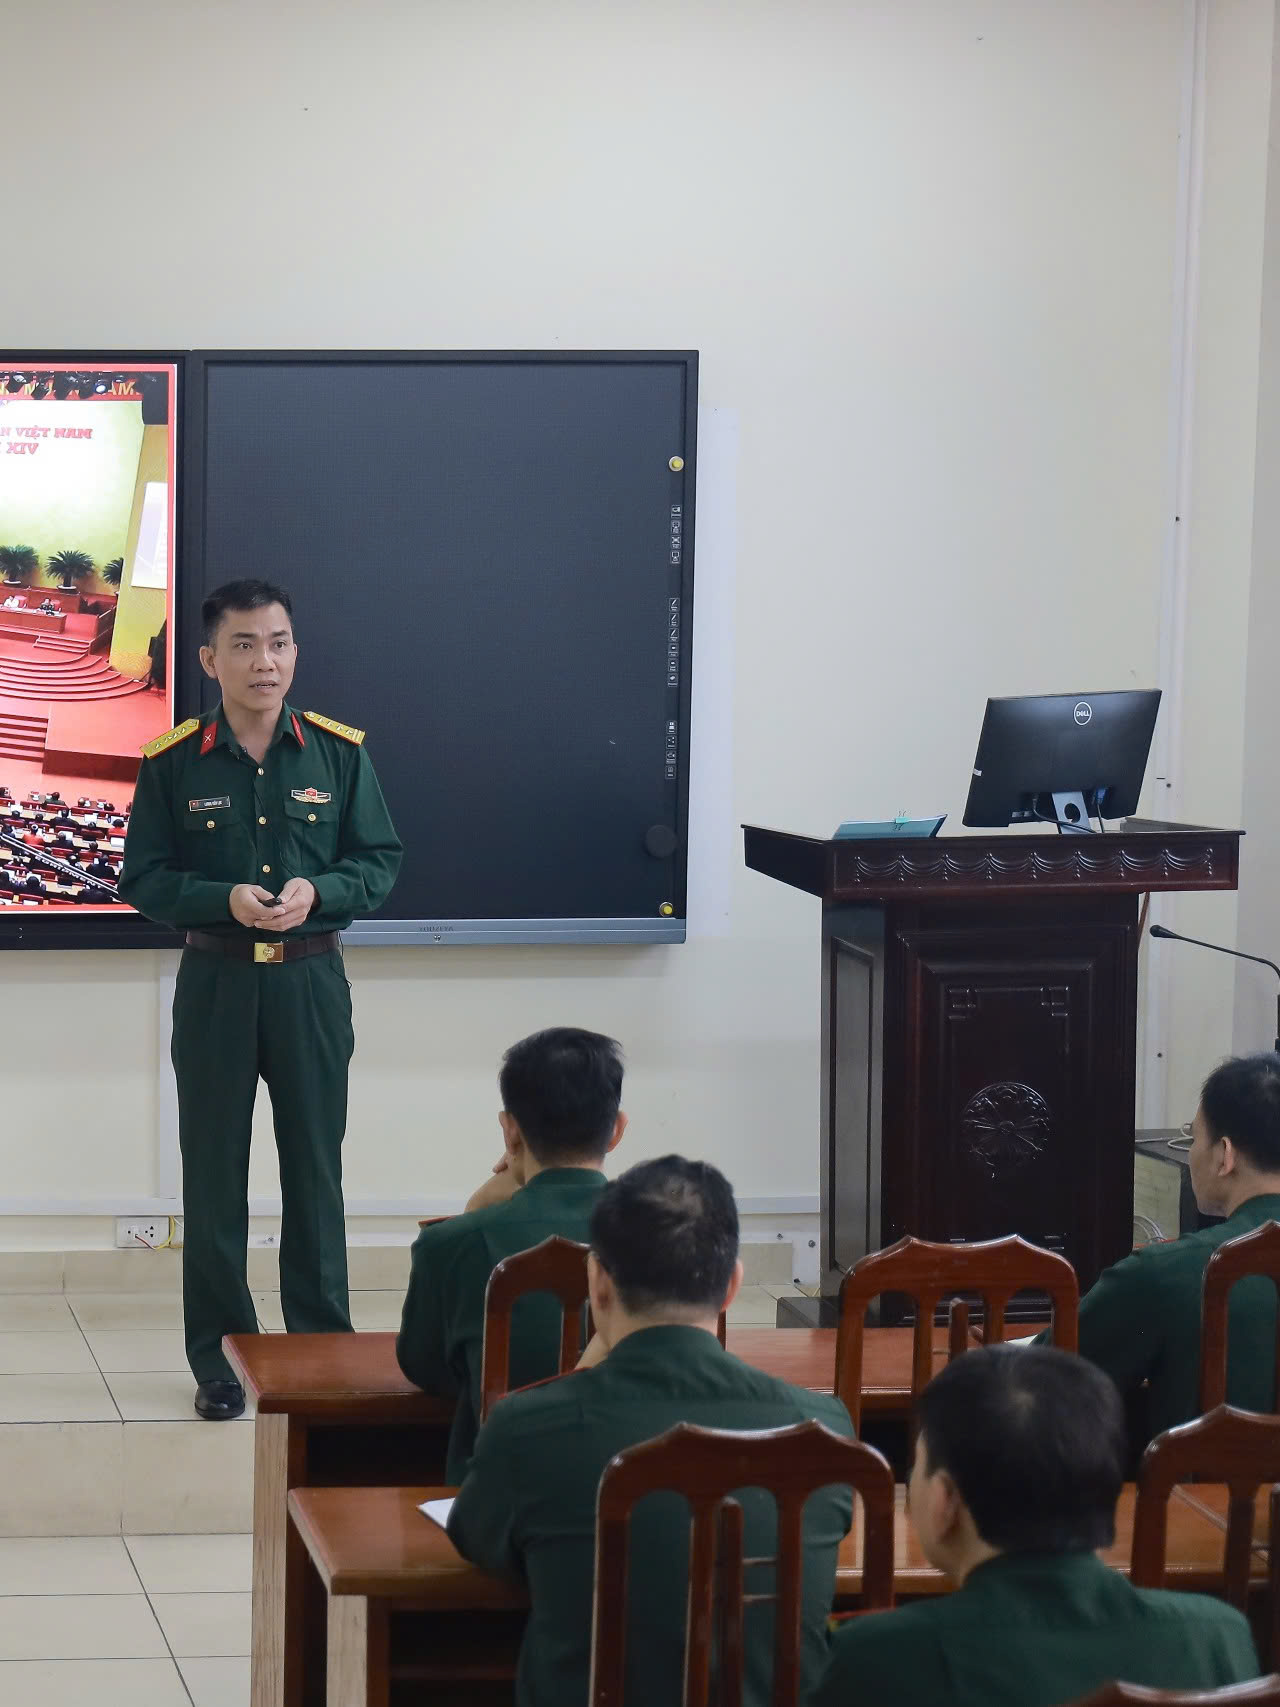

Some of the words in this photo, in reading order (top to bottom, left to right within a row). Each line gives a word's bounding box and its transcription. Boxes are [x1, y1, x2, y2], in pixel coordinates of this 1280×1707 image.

[16, 424, 51, 440] VIỆT
[54, 427, 93, 439] NAM
[6, 441, 39, 455] XIV
